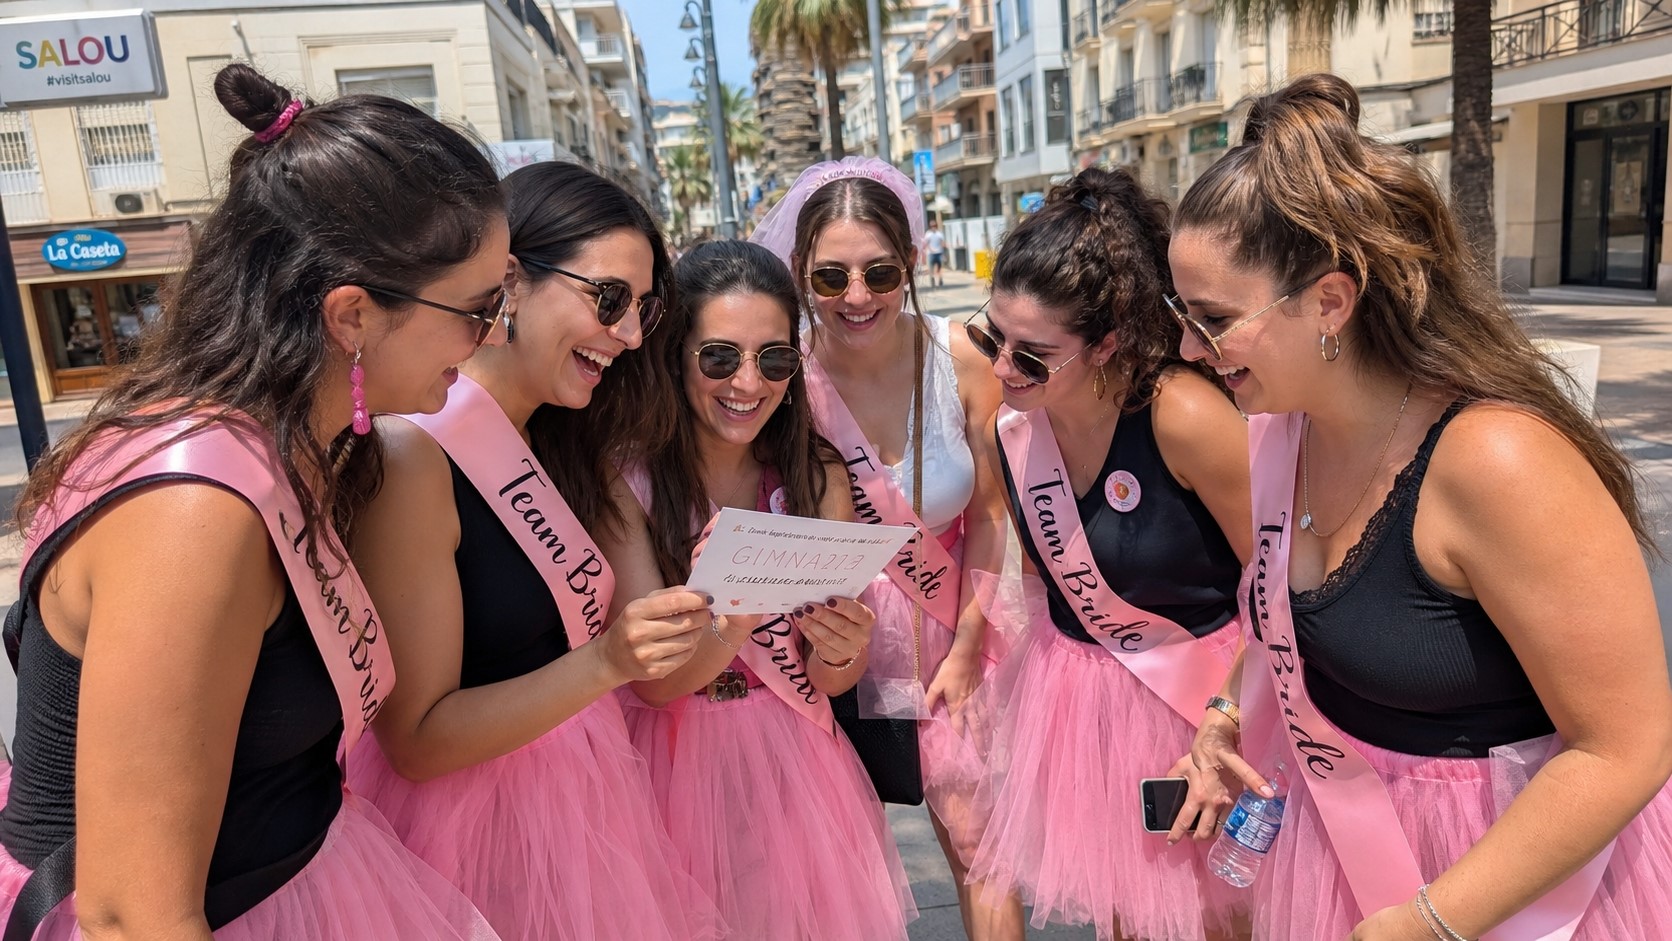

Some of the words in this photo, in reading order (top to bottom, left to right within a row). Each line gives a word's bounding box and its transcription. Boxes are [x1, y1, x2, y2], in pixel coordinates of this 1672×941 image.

[16, 35, 130, 69] SALOU
[47, 72, 111, 86] #visitsalou
[47, 244, 68, 261] La
[70, 241, 121, 260] Caseta
[499, 458, 567, 564] Team
[1028, 468, 1066, 564] Team
[1060, 562, 1150, 651] Bride
[1258, 511, 1287, 630] Team
[1267, 635, 1345, 780] Bride
